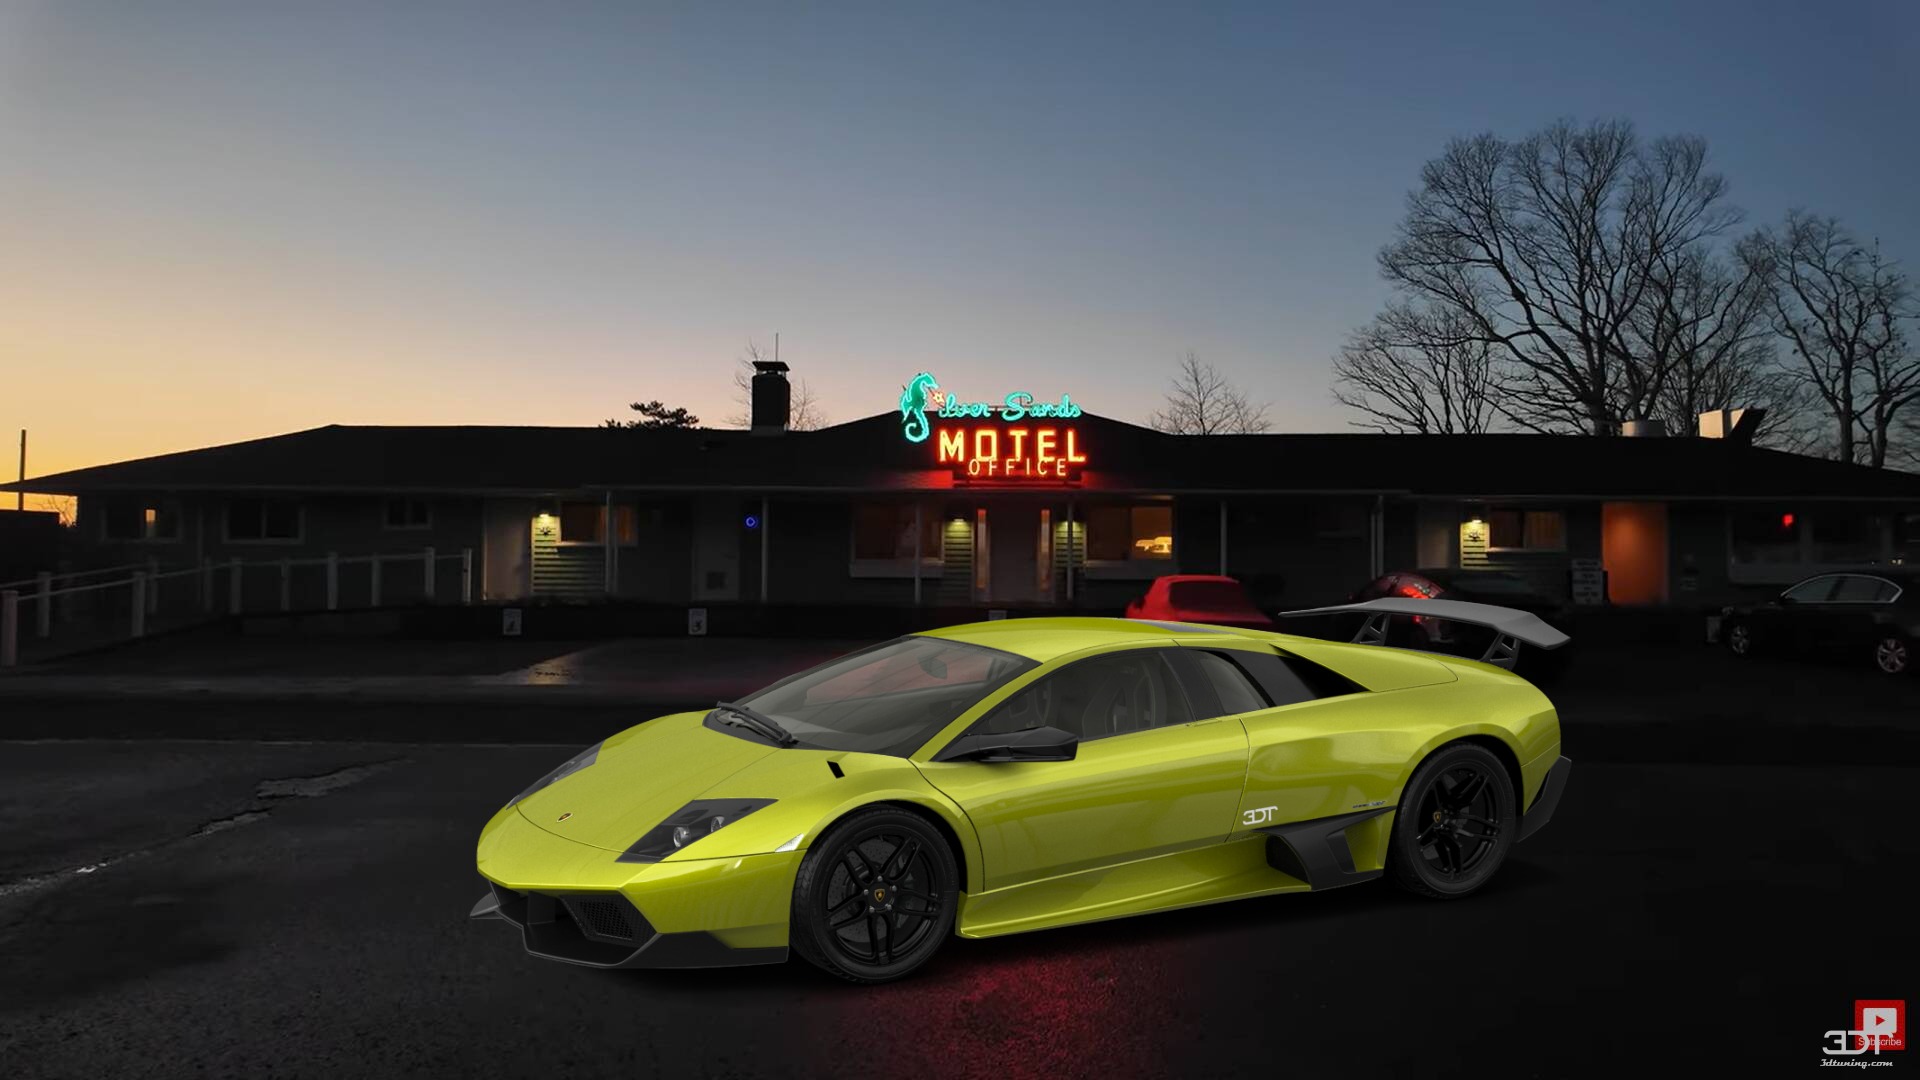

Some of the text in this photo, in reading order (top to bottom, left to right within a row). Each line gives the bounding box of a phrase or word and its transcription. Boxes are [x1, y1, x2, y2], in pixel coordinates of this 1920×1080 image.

[1002, 391, 1081, 421] Sands
[938, 428, 1087, 463] MOTEL
[968, 458, 1067, 476] OFFICE
